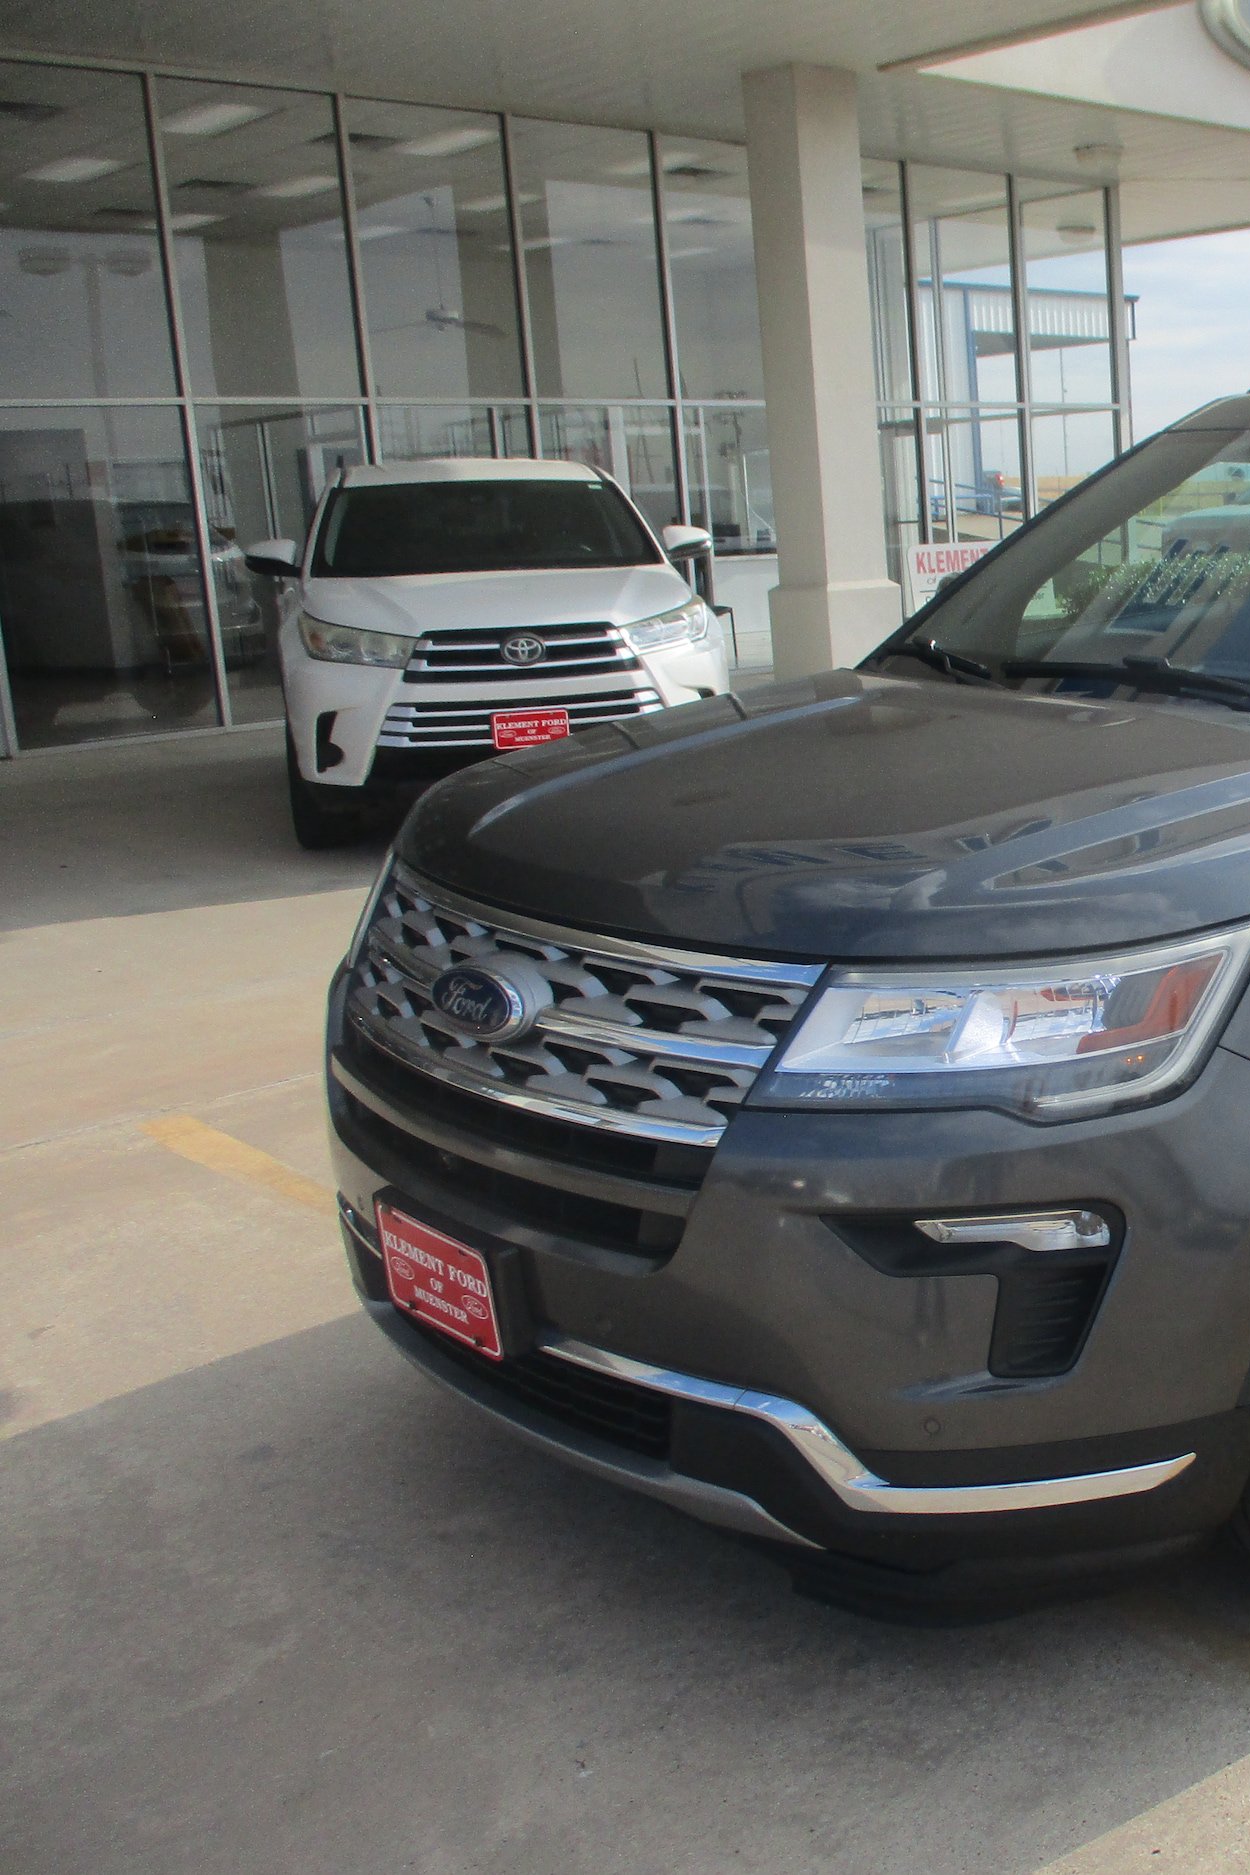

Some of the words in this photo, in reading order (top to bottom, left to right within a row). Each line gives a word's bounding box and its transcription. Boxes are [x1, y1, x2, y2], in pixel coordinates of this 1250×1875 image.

[496, 720, 539, 730] KLEMENT
[541, 718, 567, 727] FORD
[441, 975, 492, 1022] Ford
[383, 1230, 445, 1276] KLEMENT
[446, 1264, 487, 1298] FORD
[413, 1285, 469, 1325] MUENSTER
[429, 1277, 444, 1293] OF
